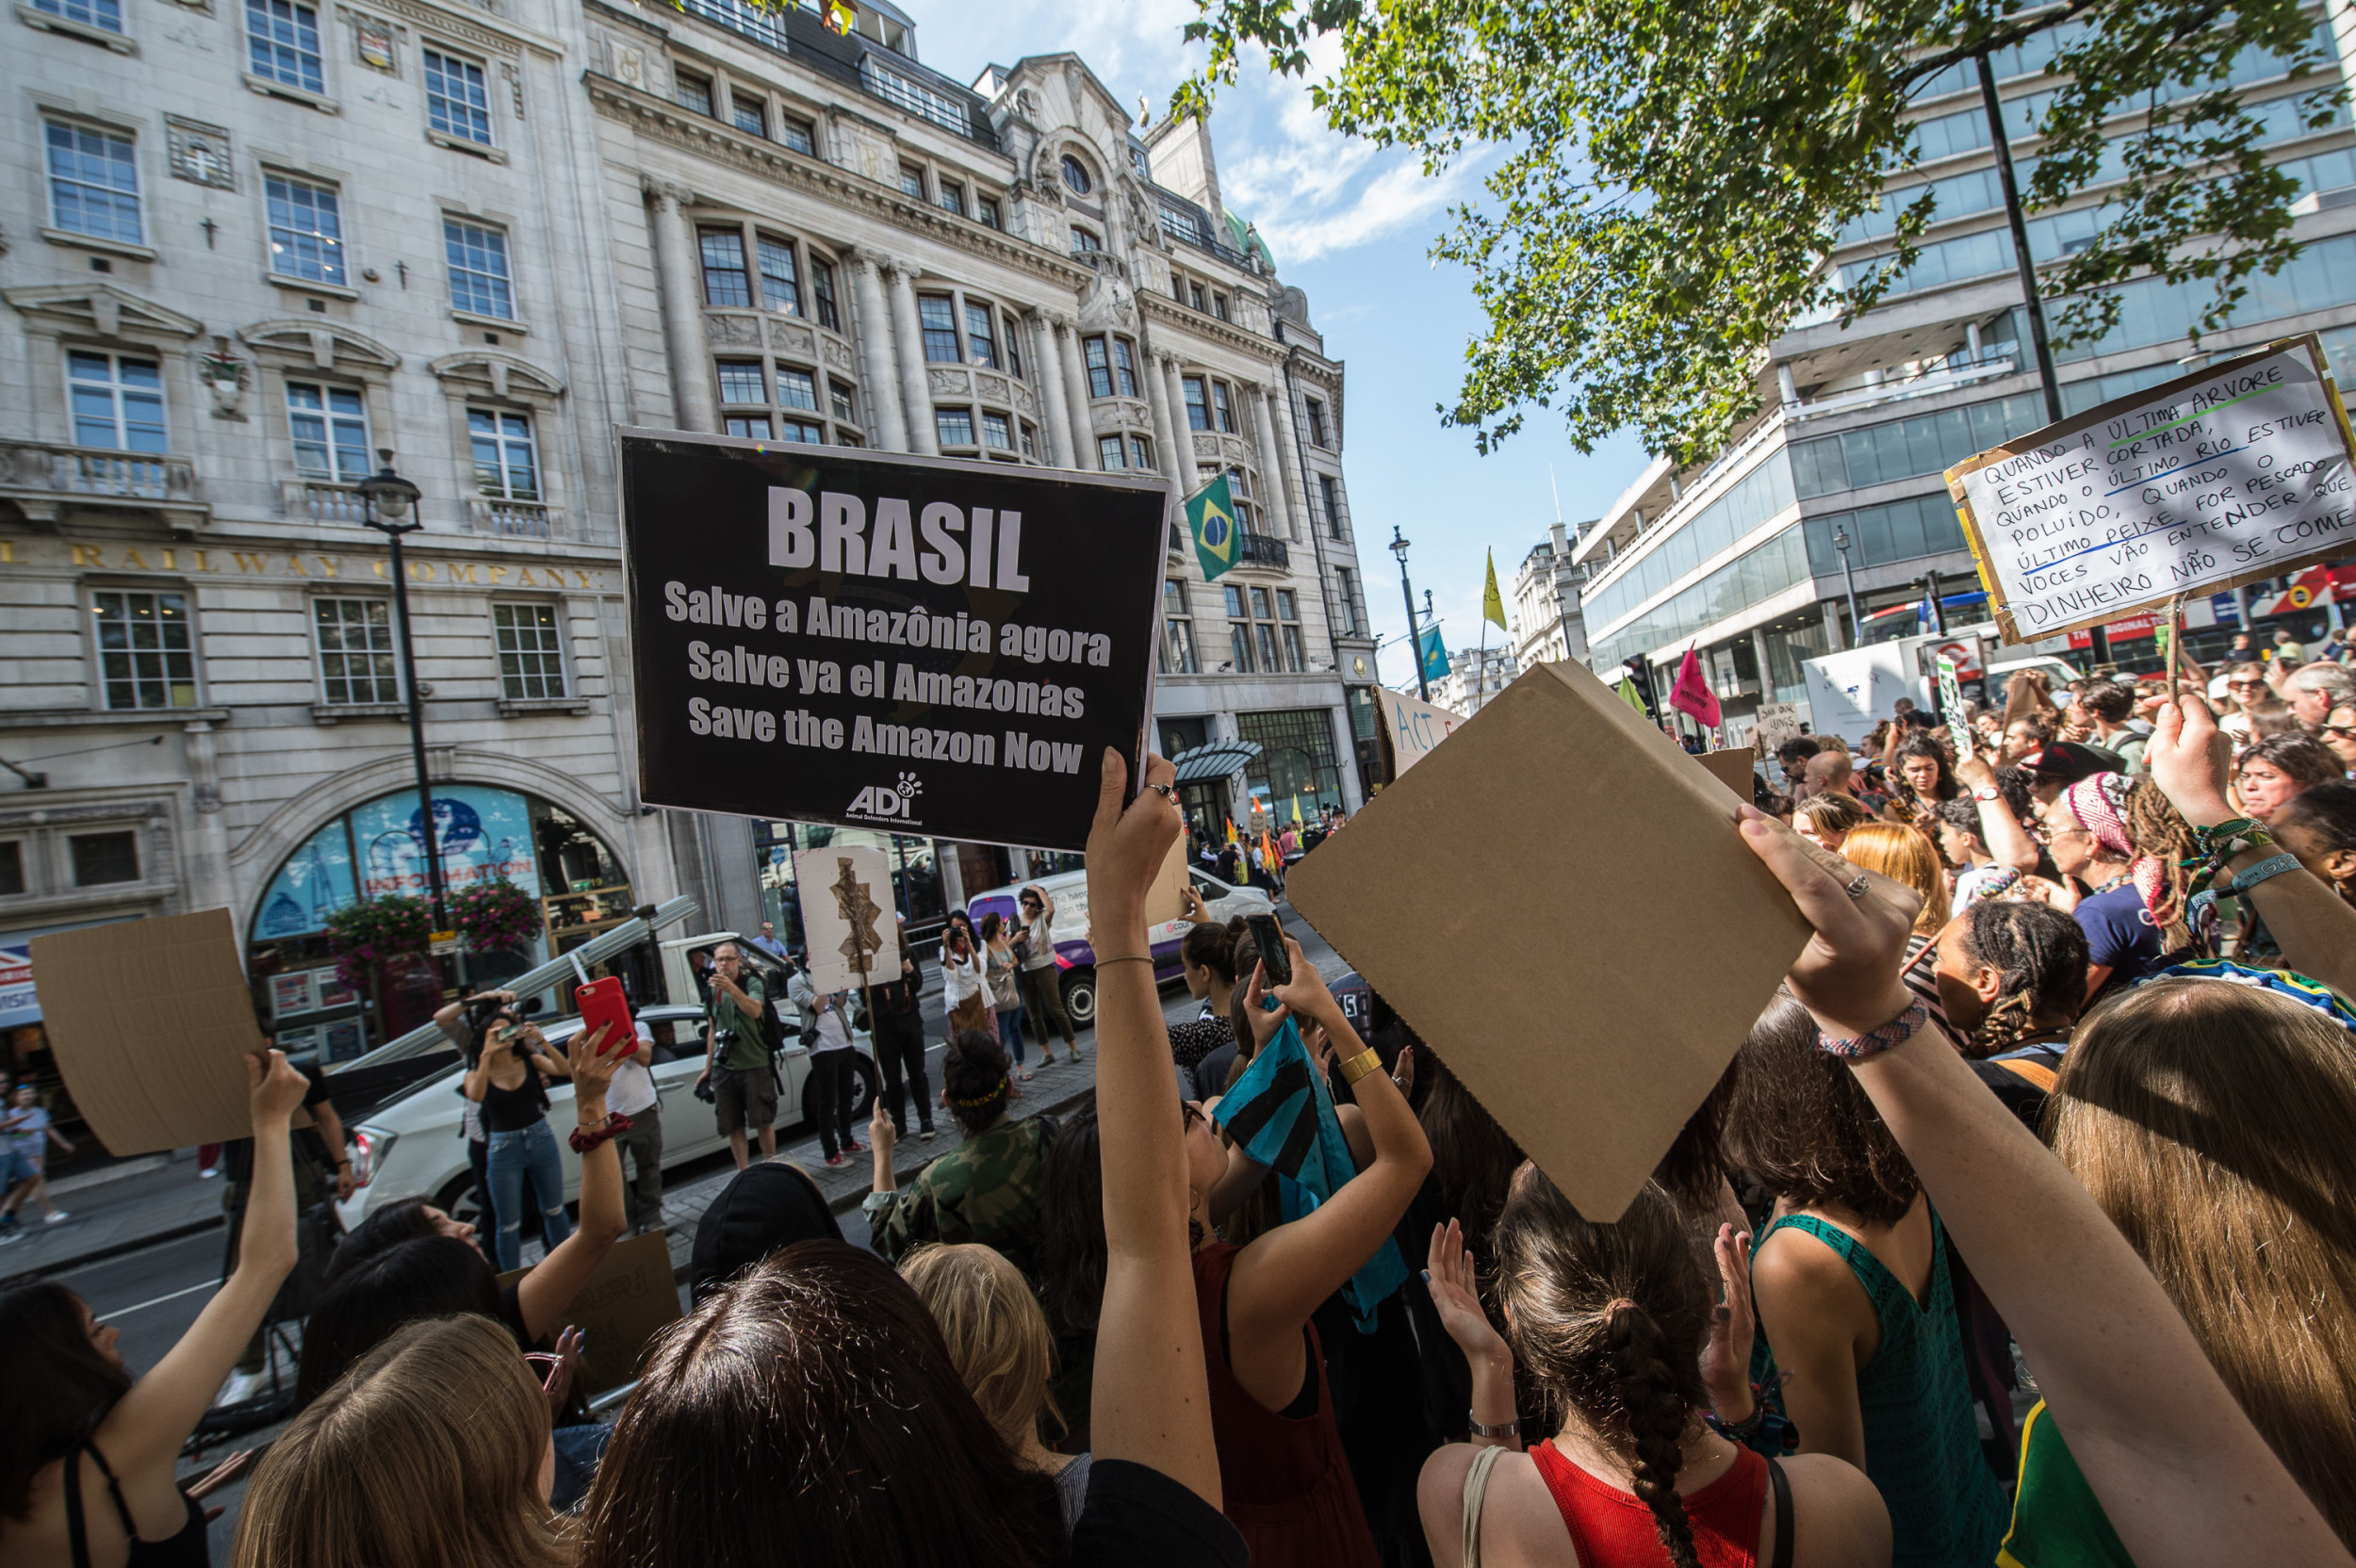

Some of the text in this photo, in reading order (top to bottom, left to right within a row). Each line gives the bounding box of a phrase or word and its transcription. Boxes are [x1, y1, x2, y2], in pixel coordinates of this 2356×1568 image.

[1984, 366, 2283, 483] QUANDO A ÚLTIMA ARVORE
[1997, 421, 2213, 506] ESTIVER CORTADA,
[1996, 409, 2326, 527] QUANDO O ÚLTIMO RIO ESTIVER
[2141, 467, 2228, 505] QUANDO
[2257, 454, 2273, 468] O
[72, 544, 341, 577] RAILWAY
[769, 486, 1029, 592] BRASIL
[2017, 537, 2091, 570] ÚLTIMO
[2105, 511, 2173, 543] PEIXE
[2195, 486, 2236, 511] FOR
[2019, 477, 2352, 596] VOCES VÃO ENTENDER QUE
[2024, 508, 2356, 625] DINHEIRO NÃO SE COME
[665, 581, 1110, 666] Salve a Amazônia agora
[2071, 629, 2089, 641] TH
[2104, 617, 2151, 635] RIGINAL
[689, 641, 1084, 718] Salve ya el Amazonas
[689, 697, 1083, 774] Save the Amazon Now
[864, 814, 889, 823] Defenders
[890, 816, 923, 826] International
[1050, 894, 1067, 906] The
[1062, 905, 1078, 915] on
